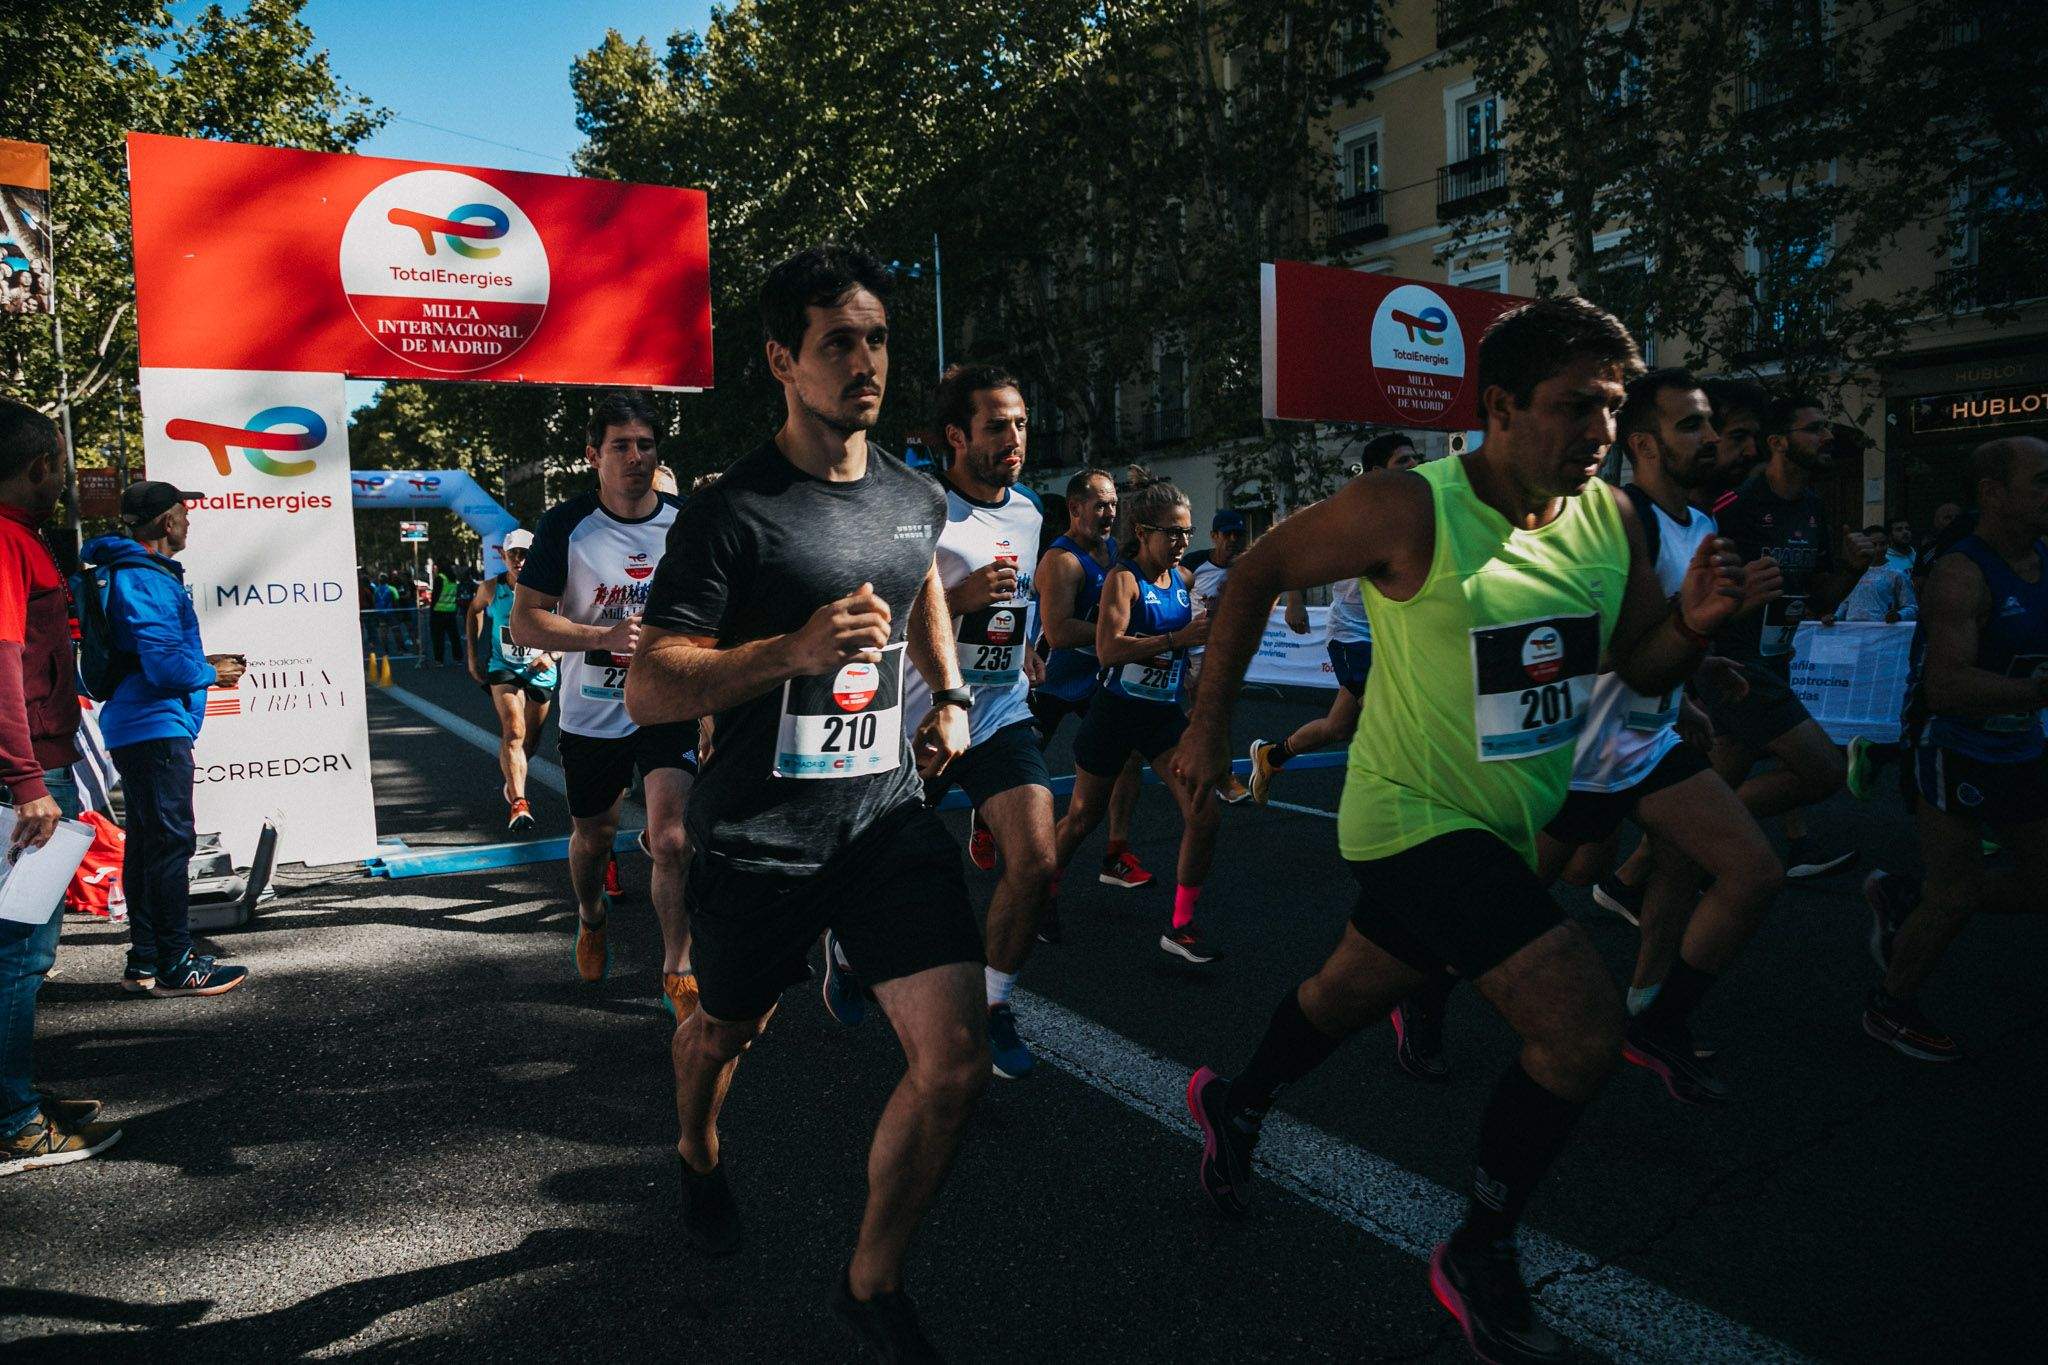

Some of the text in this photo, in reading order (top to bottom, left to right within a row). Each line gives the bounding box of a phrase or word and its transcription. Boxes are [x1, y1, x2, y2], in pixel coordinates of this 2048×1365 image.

[389, 266, 513, 289] TotalEnergies
[422, 304, 480, 320] MILLA
[402, 338, 503, 355] DE MADRID
[1393, 349, 1449, 366] TotalEnergies
[1408, 375, 1434, 387] MILLA
[1398, 399, 1444, 411] DE MADRID
[1952, 393, 2048, 419] HUBLOT
[182, 492, 333, 514] otalEnergies
[217, 582, 343, 607] MADRID
[269, 657, 313, 667] balance
[974, 646, 1012, 670] 235
[603, 667, 627, 689] 22
[1791, 676, 1849, 688] patrocina
[1520, 681, 1573, 730] 201
[821, 713, 877, 752] 210
